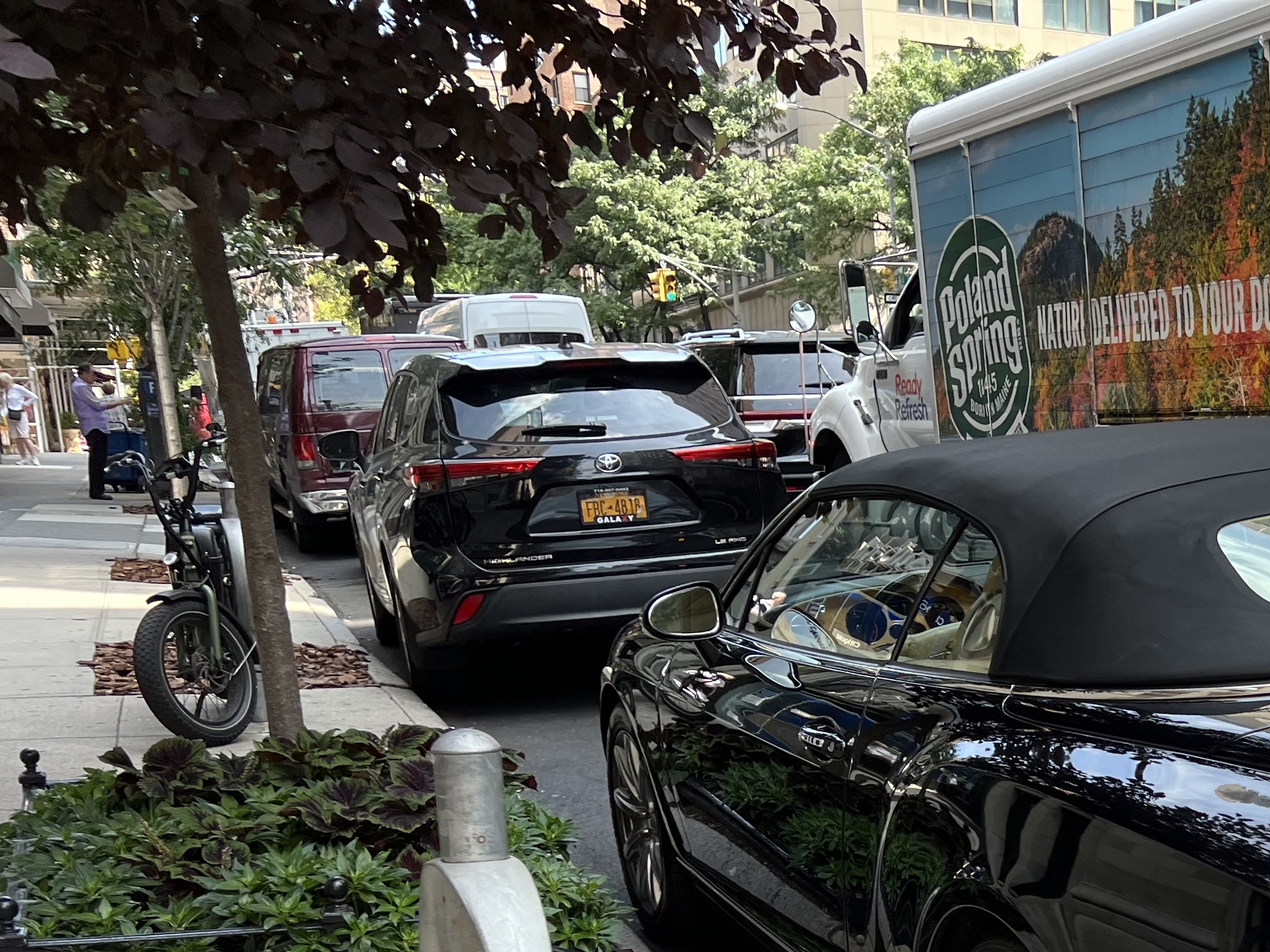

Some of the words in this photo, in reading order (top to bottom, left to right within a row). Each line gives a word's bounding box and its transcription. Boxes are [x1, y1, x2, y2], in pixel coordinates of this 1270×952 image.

[939, 245, 1015, 353] Poland
[1091, 288, 1170, 346] DELIVERED
[1172, 284, 1194, 338] TO
[1197, 279, 1246, 336] YOUR
[948, 315, 1023, 408] Spring
[895, 372, 922, 400] Ready
[895, 397, 928, 420] Refresh
[597, 515, 634, 524] GALAXY
